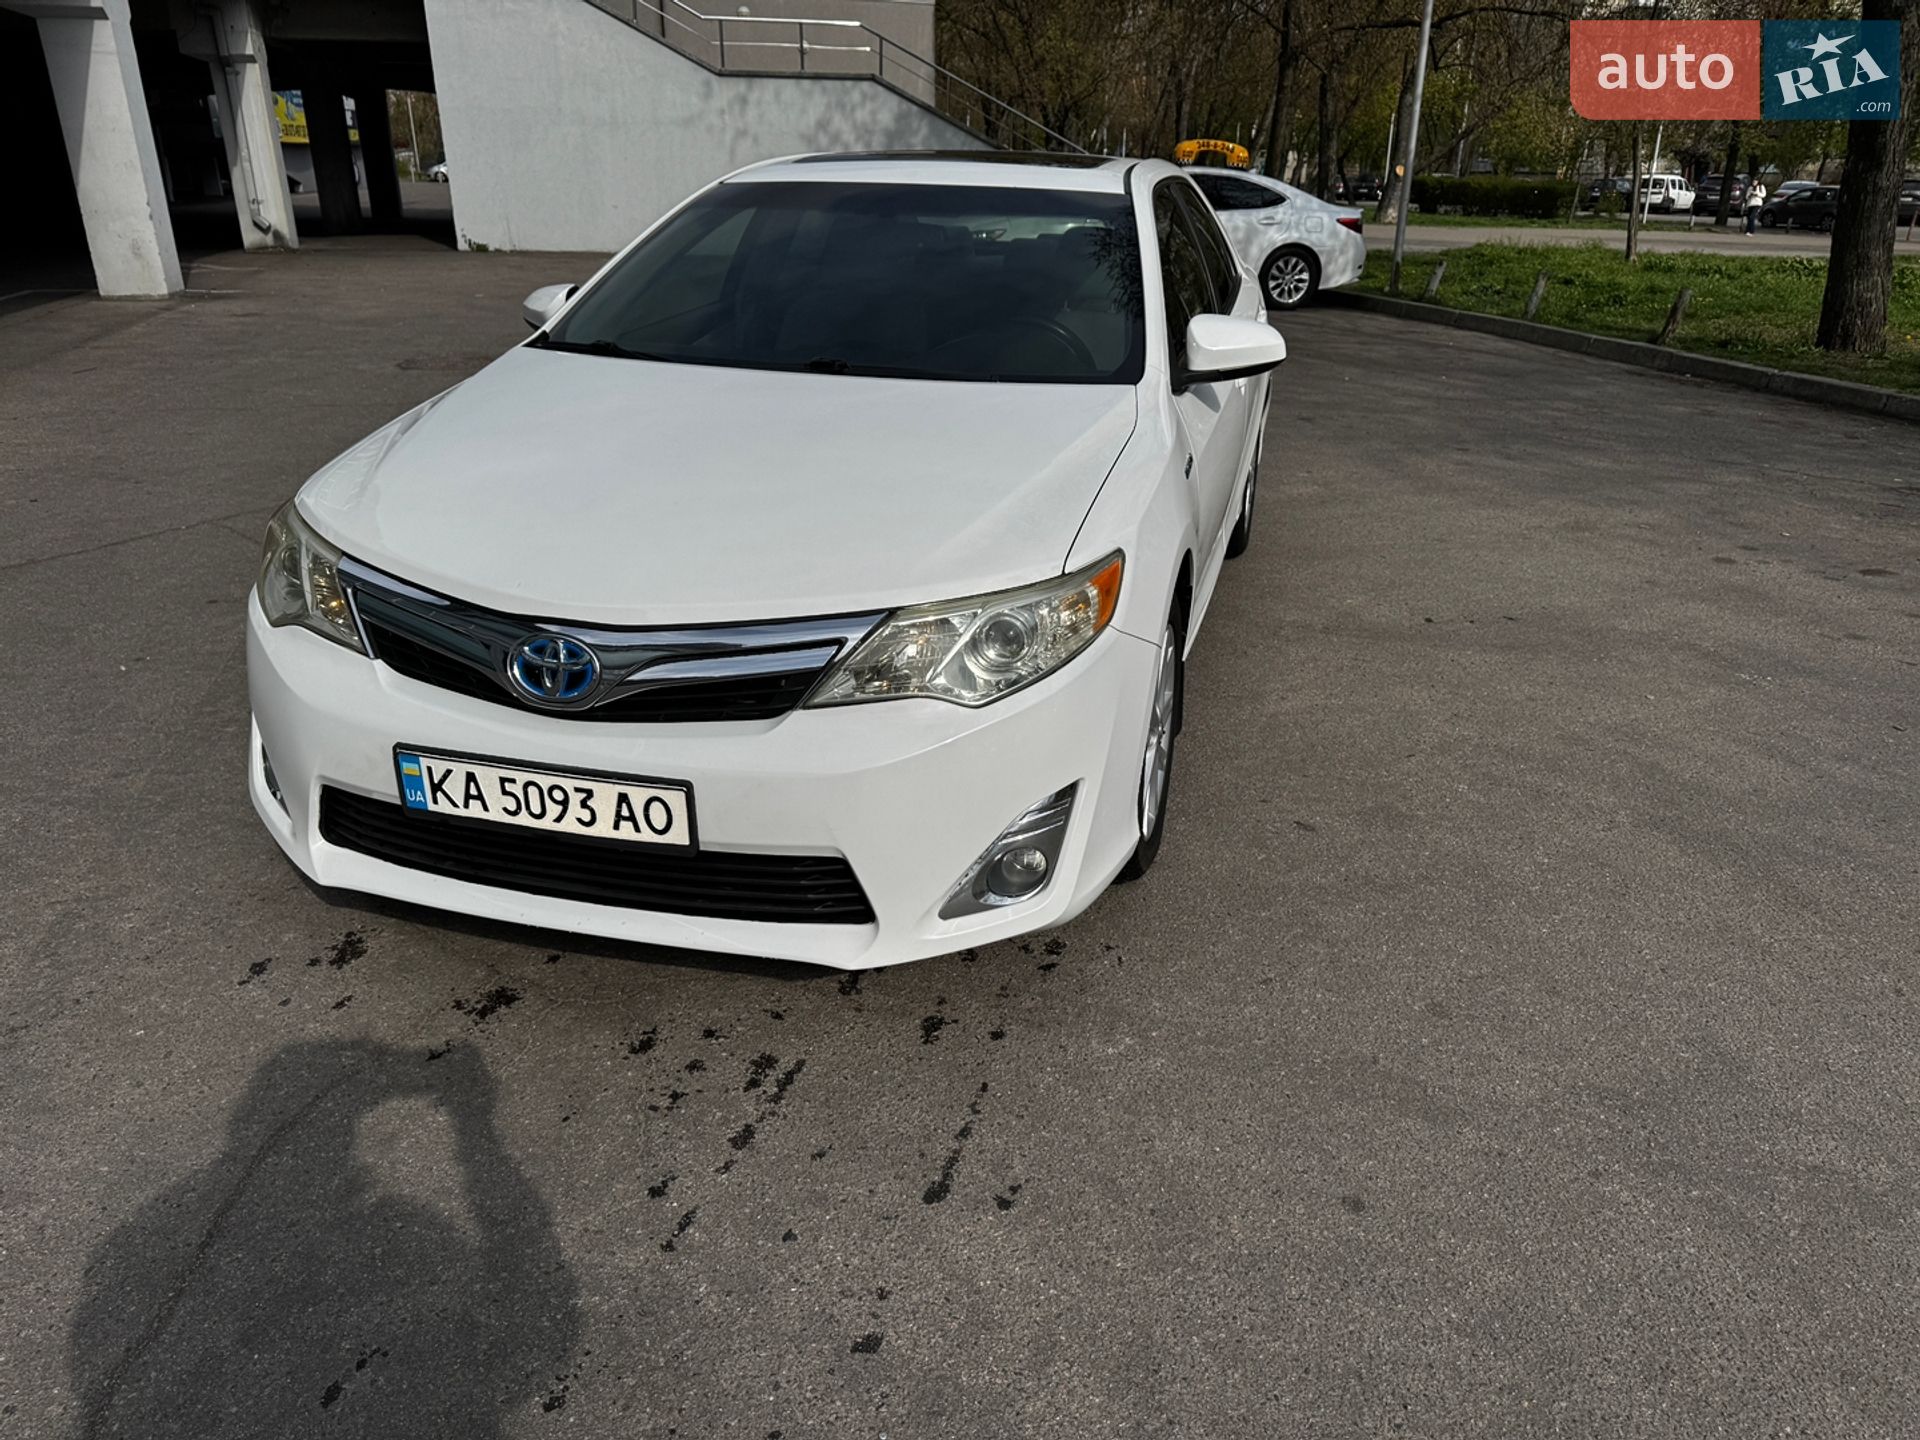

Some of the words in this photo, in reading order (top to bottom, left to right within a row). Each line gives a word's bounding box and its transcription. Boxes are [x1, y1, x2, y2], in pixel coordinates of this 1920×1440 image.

[406, 787, 425, 803] UA
[426, 765, 490, 813] KA
[498, 775, 598, 828] 5093
[612, 791, 674, 836] AO
